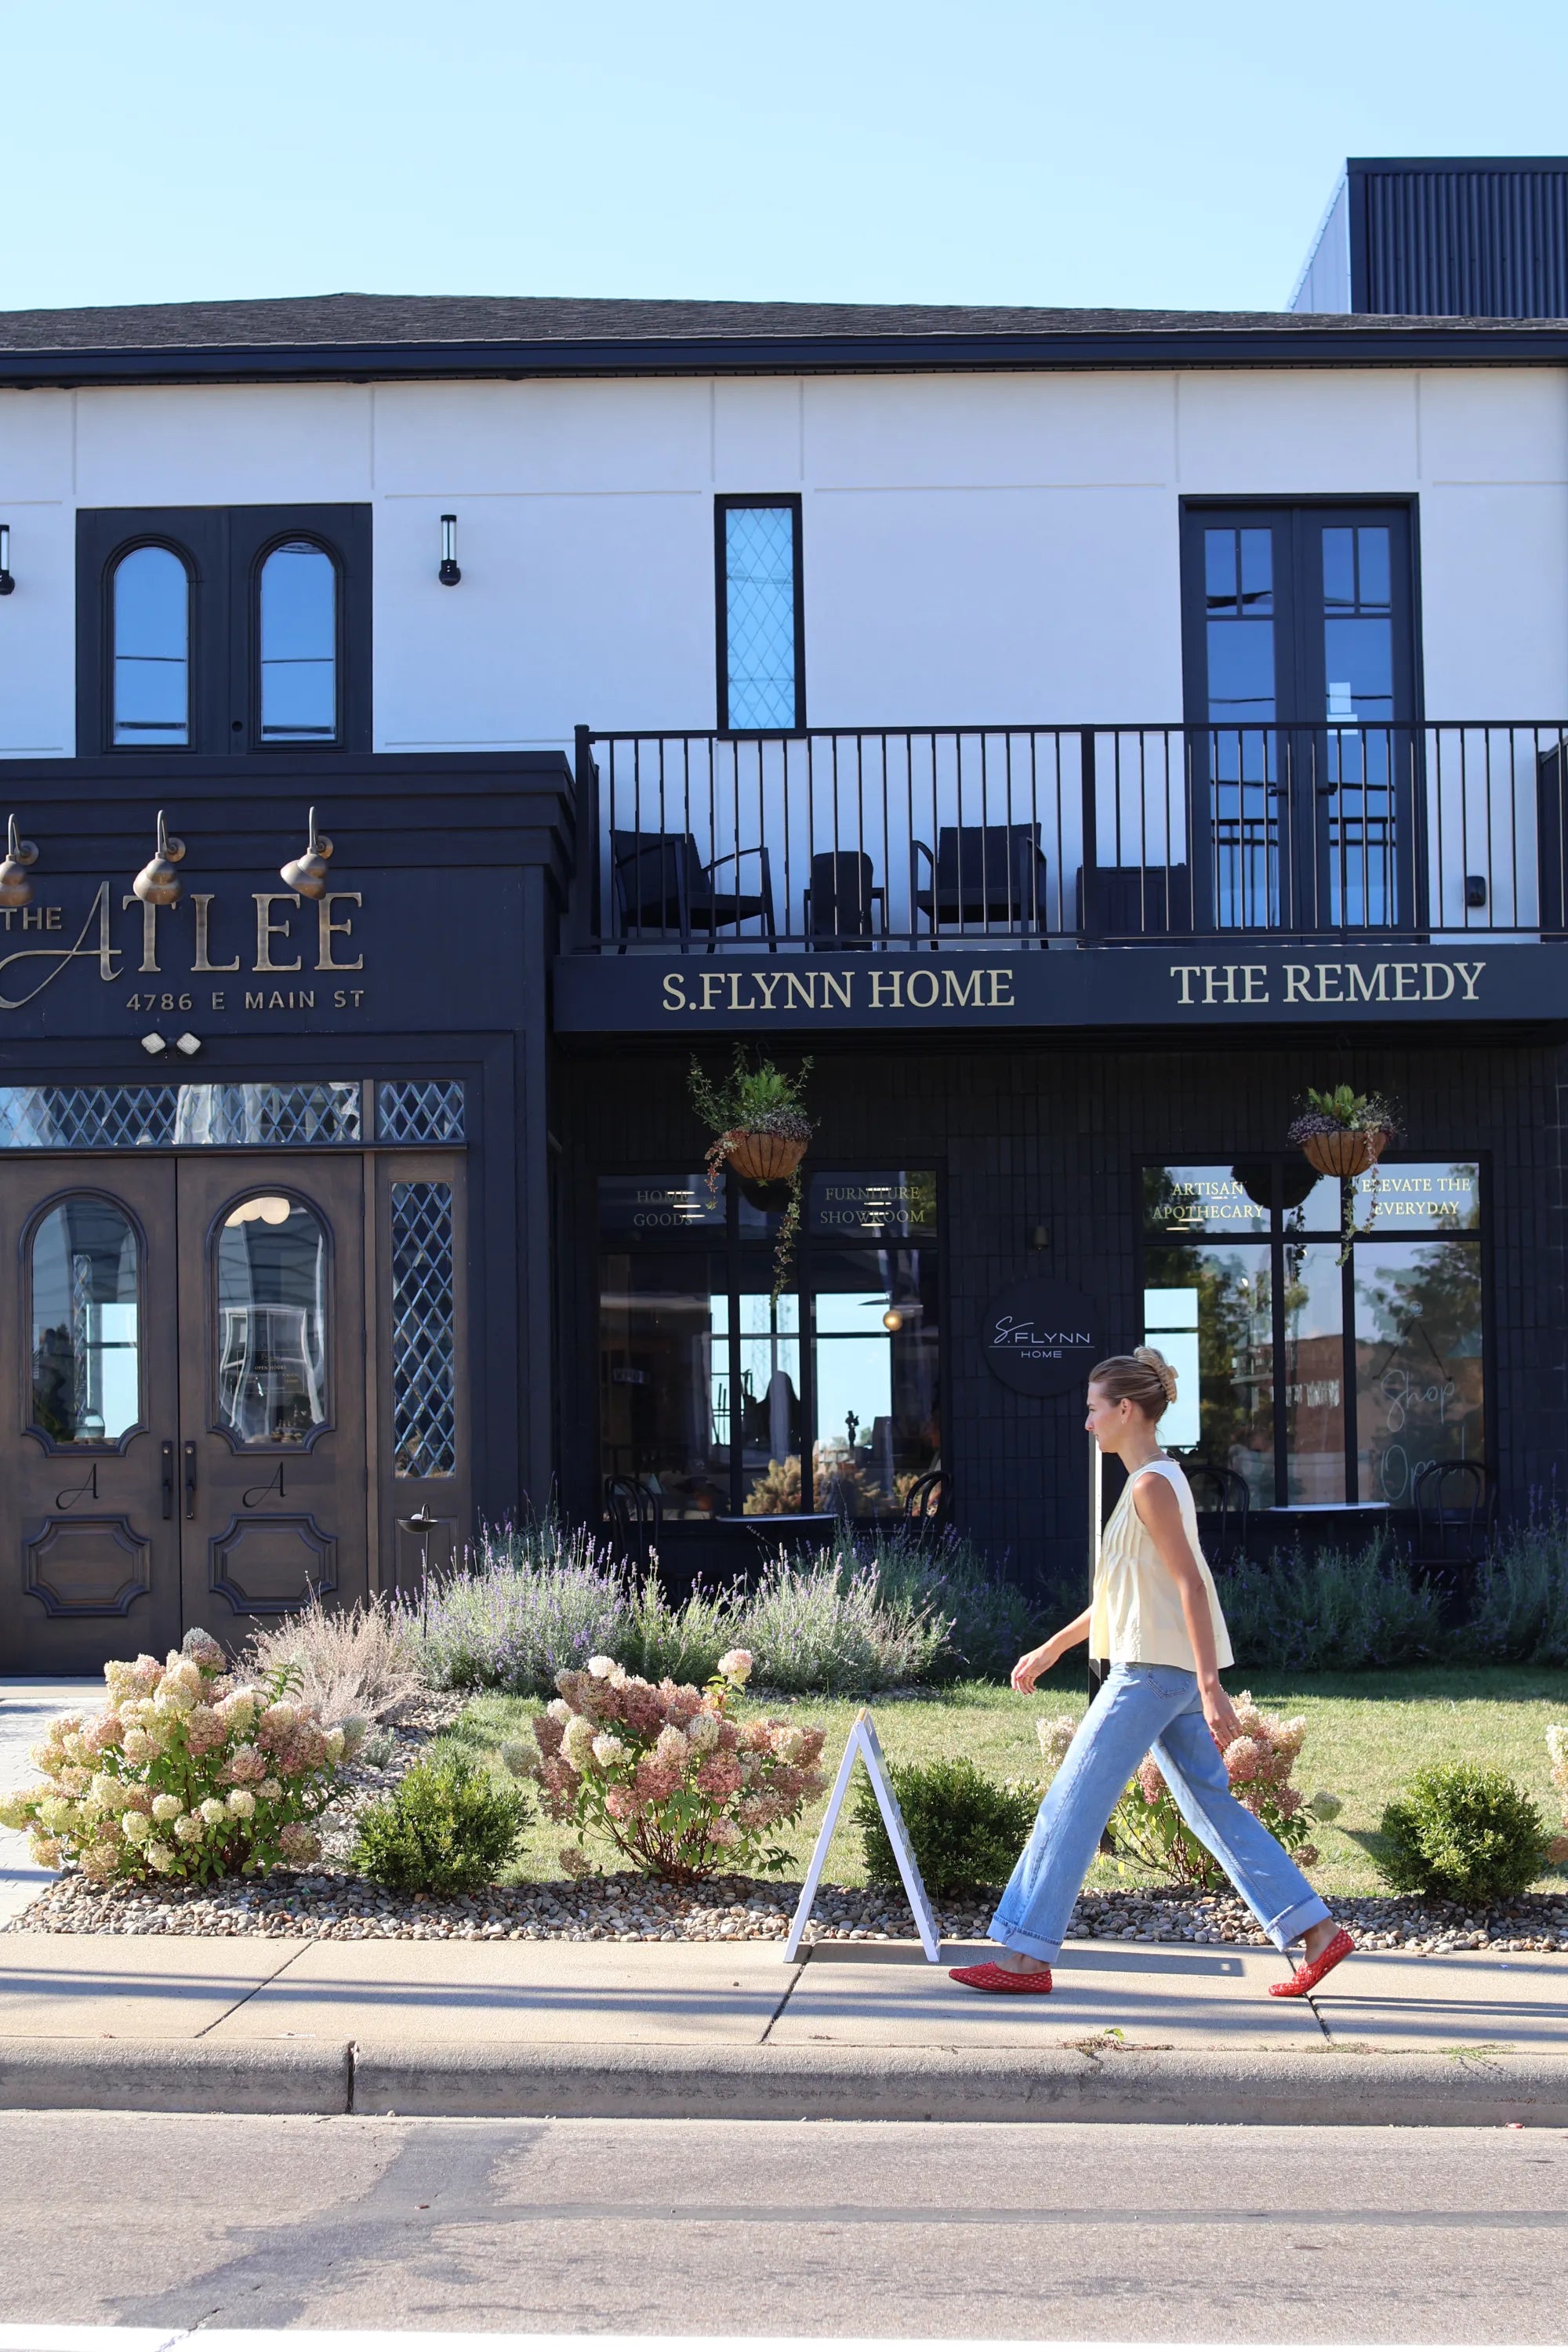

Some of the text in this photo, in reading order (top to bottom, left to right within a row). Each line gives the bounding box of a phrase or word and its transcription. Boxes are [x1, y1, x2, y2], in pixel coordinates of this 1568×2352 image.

[0, 880, 364, 1009] THE ATLEE
[662, 969, 1014, 1011] S.FLYNN HOME
[1170, 962, 1486, 1004] THE REMEDY
[126, 990, 364, 1011] 4786 E MAIN ST
[1172, 1181, 1243, 1197] ARTISAN
[1361, 1178, 1471, 1192] ELEVATE THE
[636, 1190, 690, 1204] HOME
[826, 1186, 920, 1200] FURNITURE
[1152, 1205, 1265, 1220] APOTHECARY
[1375, 1201, 1460, 1215] EVERYDAY
[633, 1213, 693, 1227] GOODS
[820, 1210, 925, 1225] SHOWROOM
[994, 1316, 1090, 1344] S.FLYNN
[1381, 1370, 1455, 1432] Shop
